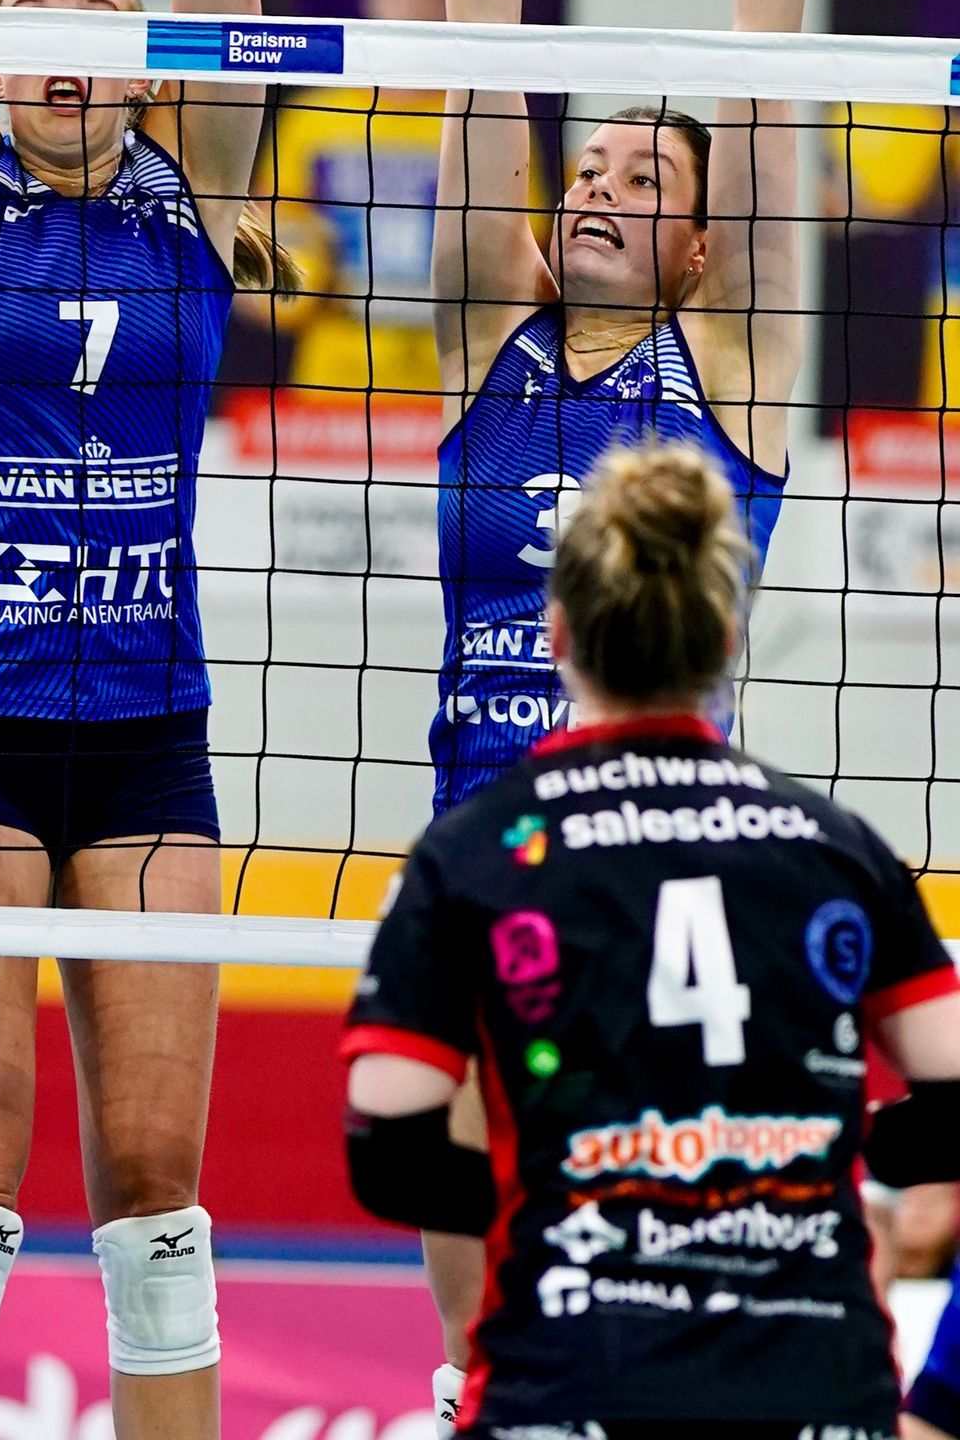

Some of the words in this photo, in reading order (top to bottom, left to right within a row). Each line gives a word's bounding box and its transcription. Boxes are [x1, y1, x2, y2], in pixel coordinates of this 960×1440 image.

[228, 31, 307, 49] Draisma
[228, 46, 283, 64] Bouw
[58, 300, 120, 396] 7
[87, 464, 179, 499] BEEST
[516, 473, 583, 568] 3
[461, 628, 524, 656] VAN
[646, 874, 752, 1068] 4
